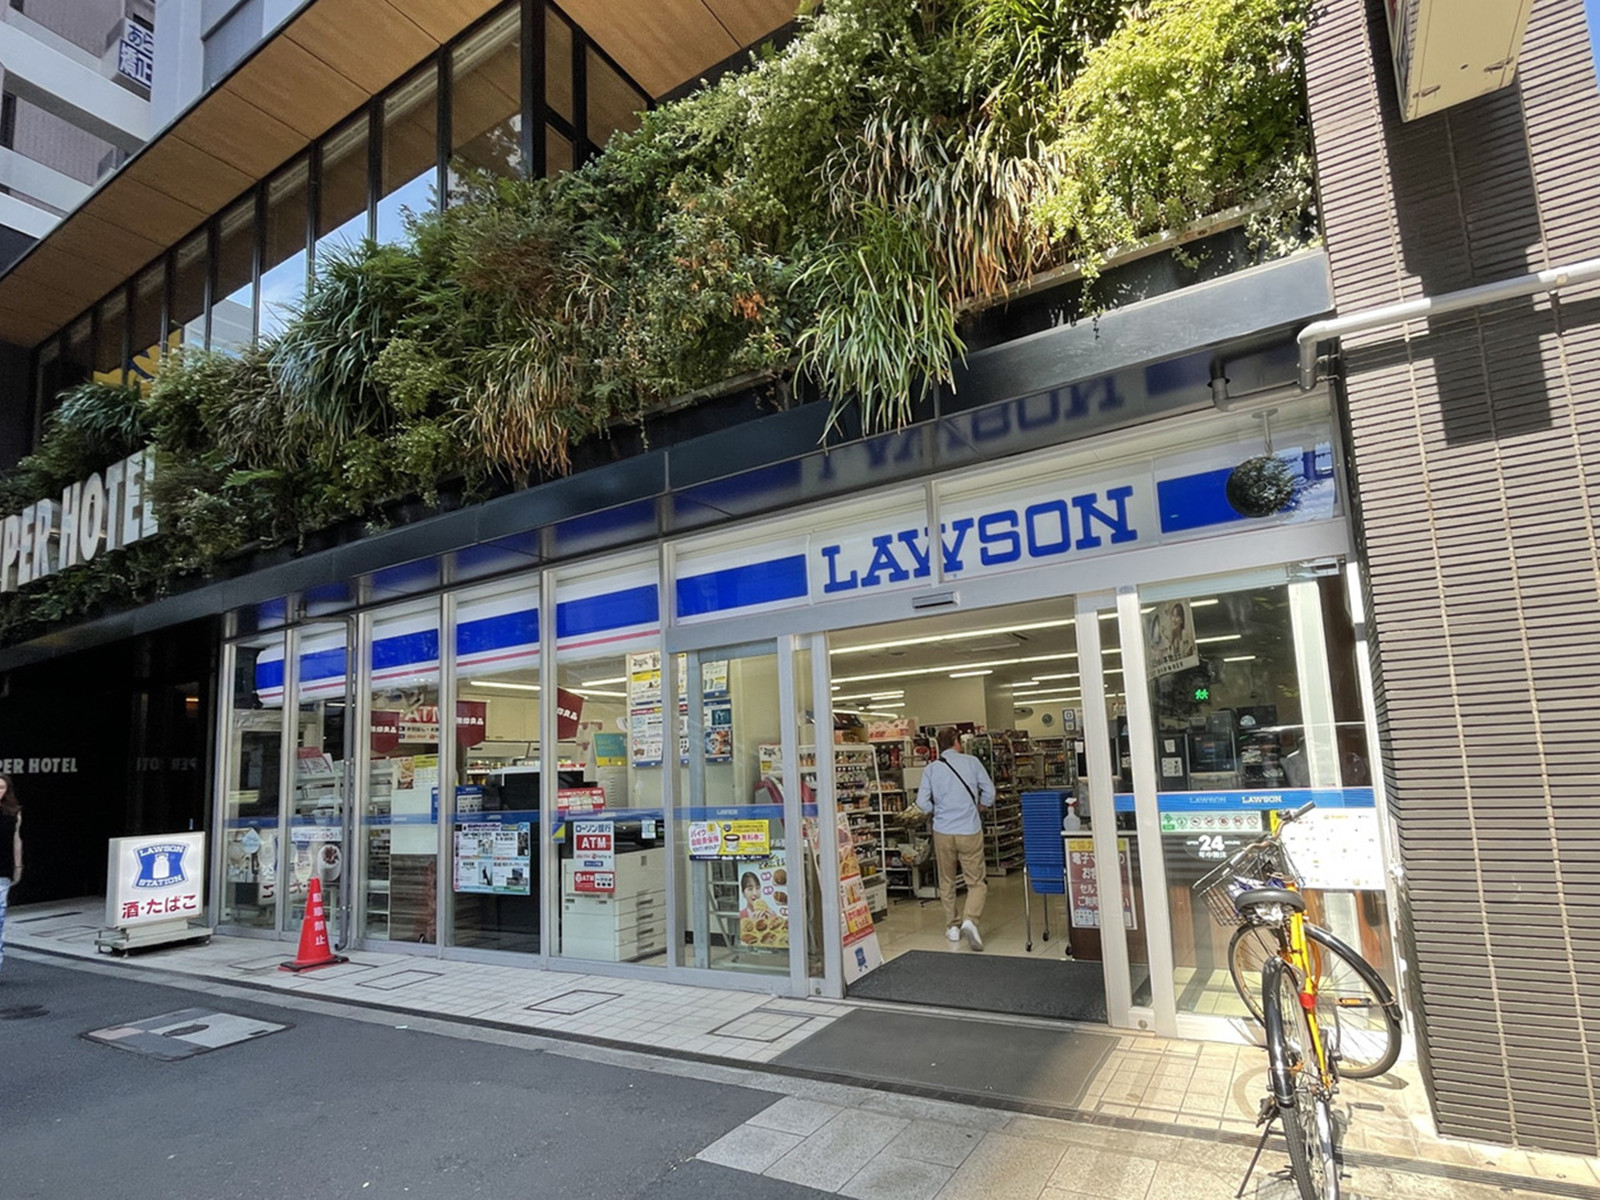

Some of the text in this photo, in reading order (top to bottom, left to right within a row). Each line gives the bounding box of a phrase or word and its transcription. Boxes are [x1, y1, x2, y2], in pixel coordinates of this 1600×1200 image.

[58, 448, 159, 570] HOTEL
[821, 486, 1139, 593] LAWSON
[28, 757, 78, 773] HOTEL
[1241, 794, 1282, 804] LAWSON
[138, 844, 185, 857] LAWSON
[581, 836, 607, 849] ATM
[1198, 834, 1225, 851] 24
[138, 874, 183, 887] STATION
[122, 894, 197, 919] 酒・たばこ
